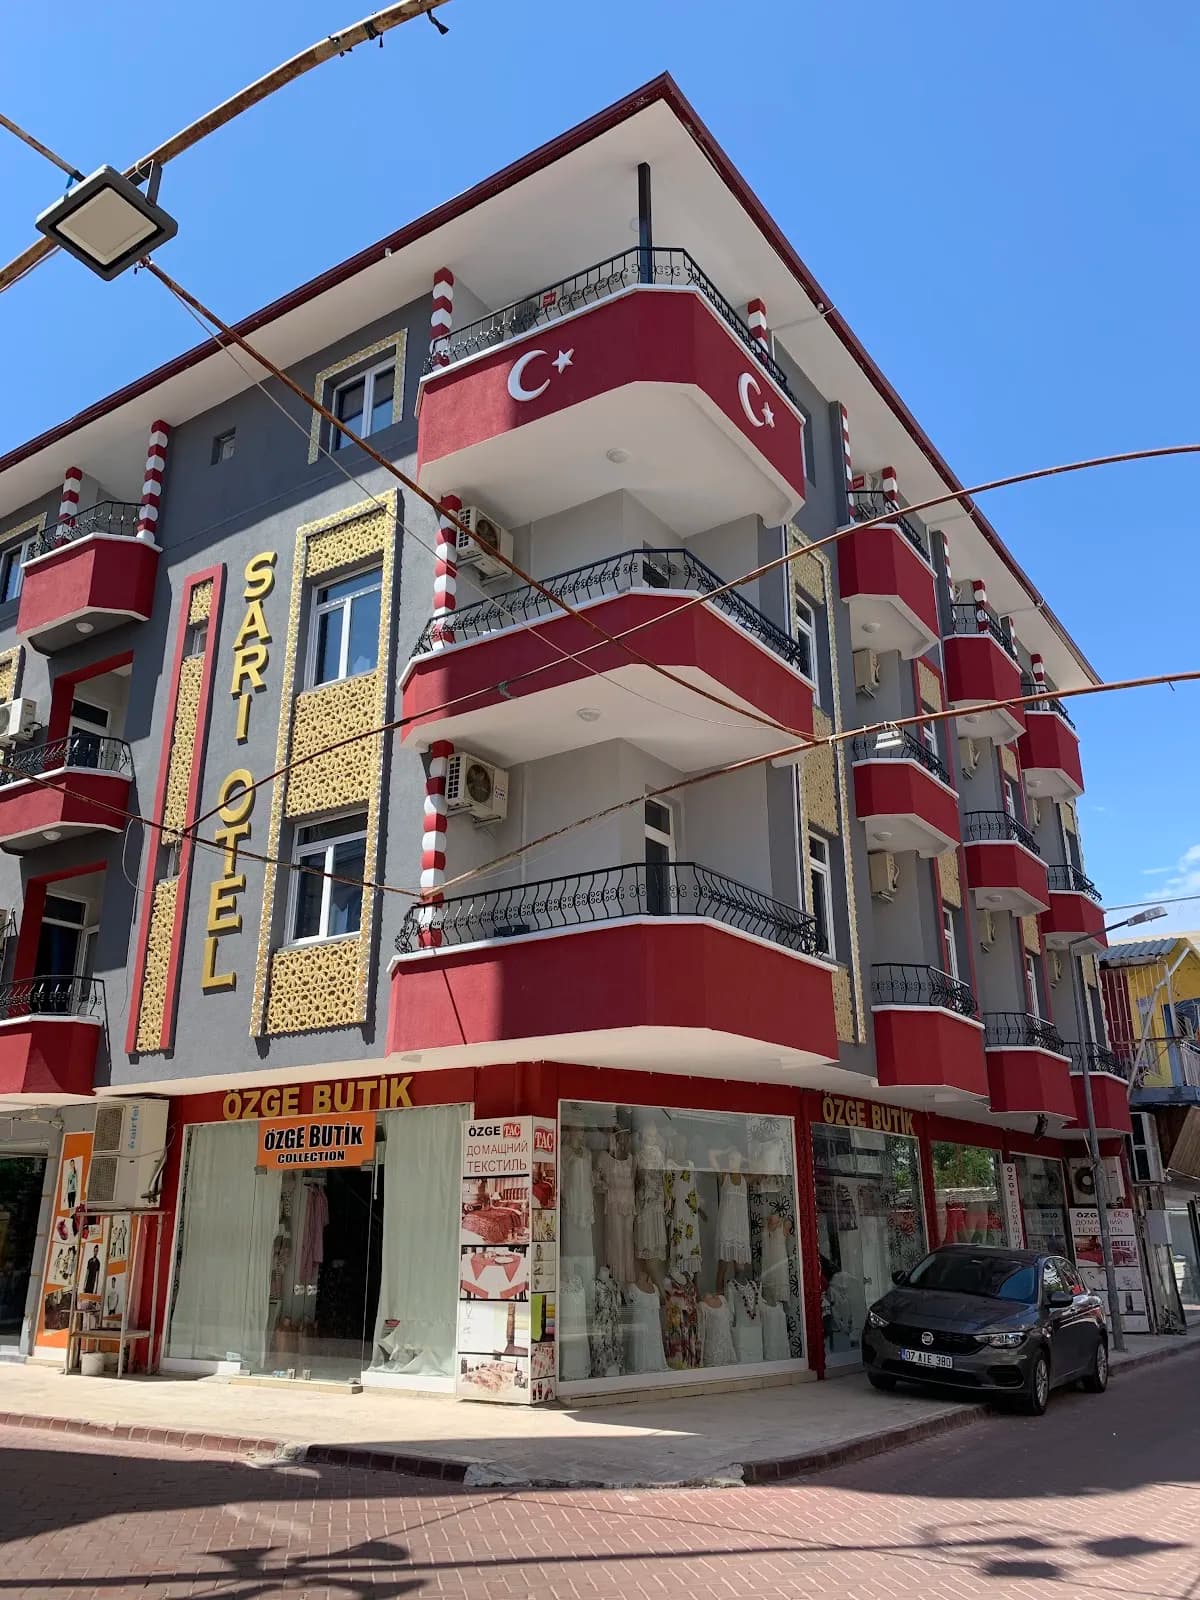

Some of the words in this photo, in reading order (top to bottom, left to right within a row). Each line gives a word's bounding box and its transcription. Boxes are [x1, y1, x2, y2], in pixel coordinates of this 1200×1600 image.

[229, 551, 277, 743] SARI
[202, 768, 254, 994] OTEL
[222, 1087, 299, 1120] ÖZGE
[312, 1074, 413, 1113] BUTİK
[822, 1091, 866, 1127] ÖZGE
[871, 1104, 916, 1136] BUTİK
[264, 1127, 305, 1150] ÖZGE
[309, 1123, 363, 1148] BUTİK
[468, 1125, 501, 1137] ÖZGE
[277, 1150, 345, 1163] COLLECTION
[467, 1141, 528, 1157] ДОМАЩНИЙ
[466, 1158, 527, 1173] ТЕКСТИЛЬ
[906, 1351, 915, 1361] 07
